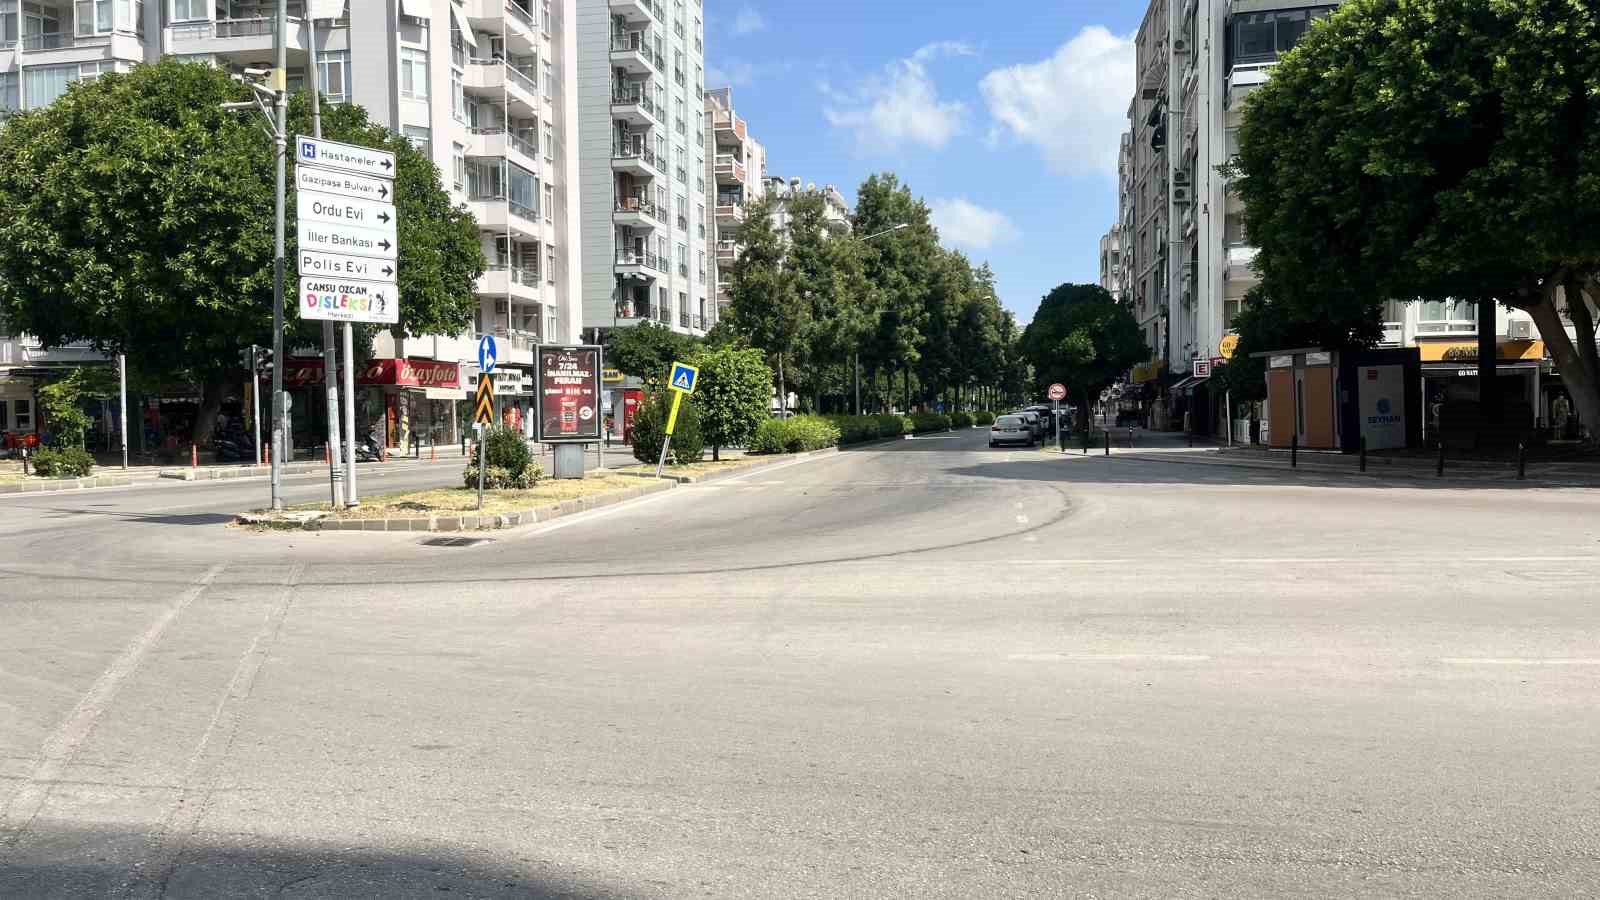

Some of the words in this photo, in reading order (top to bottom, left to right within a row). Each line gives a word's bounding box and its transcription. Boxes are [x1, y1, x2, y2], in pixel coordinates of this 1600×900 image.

[304, 145, 314, 158] H
[321, 149, 375, 167] Hastaneler
[313, 202, 342, 217] Ordu
[346, 206, 364, 220] Evi
[331, 234, 373, 249] Bankası
[303, 256, 341, 271] Polis
[346, 261, 368, 273] Evi
[306, 282, 336, 293] CANSU
